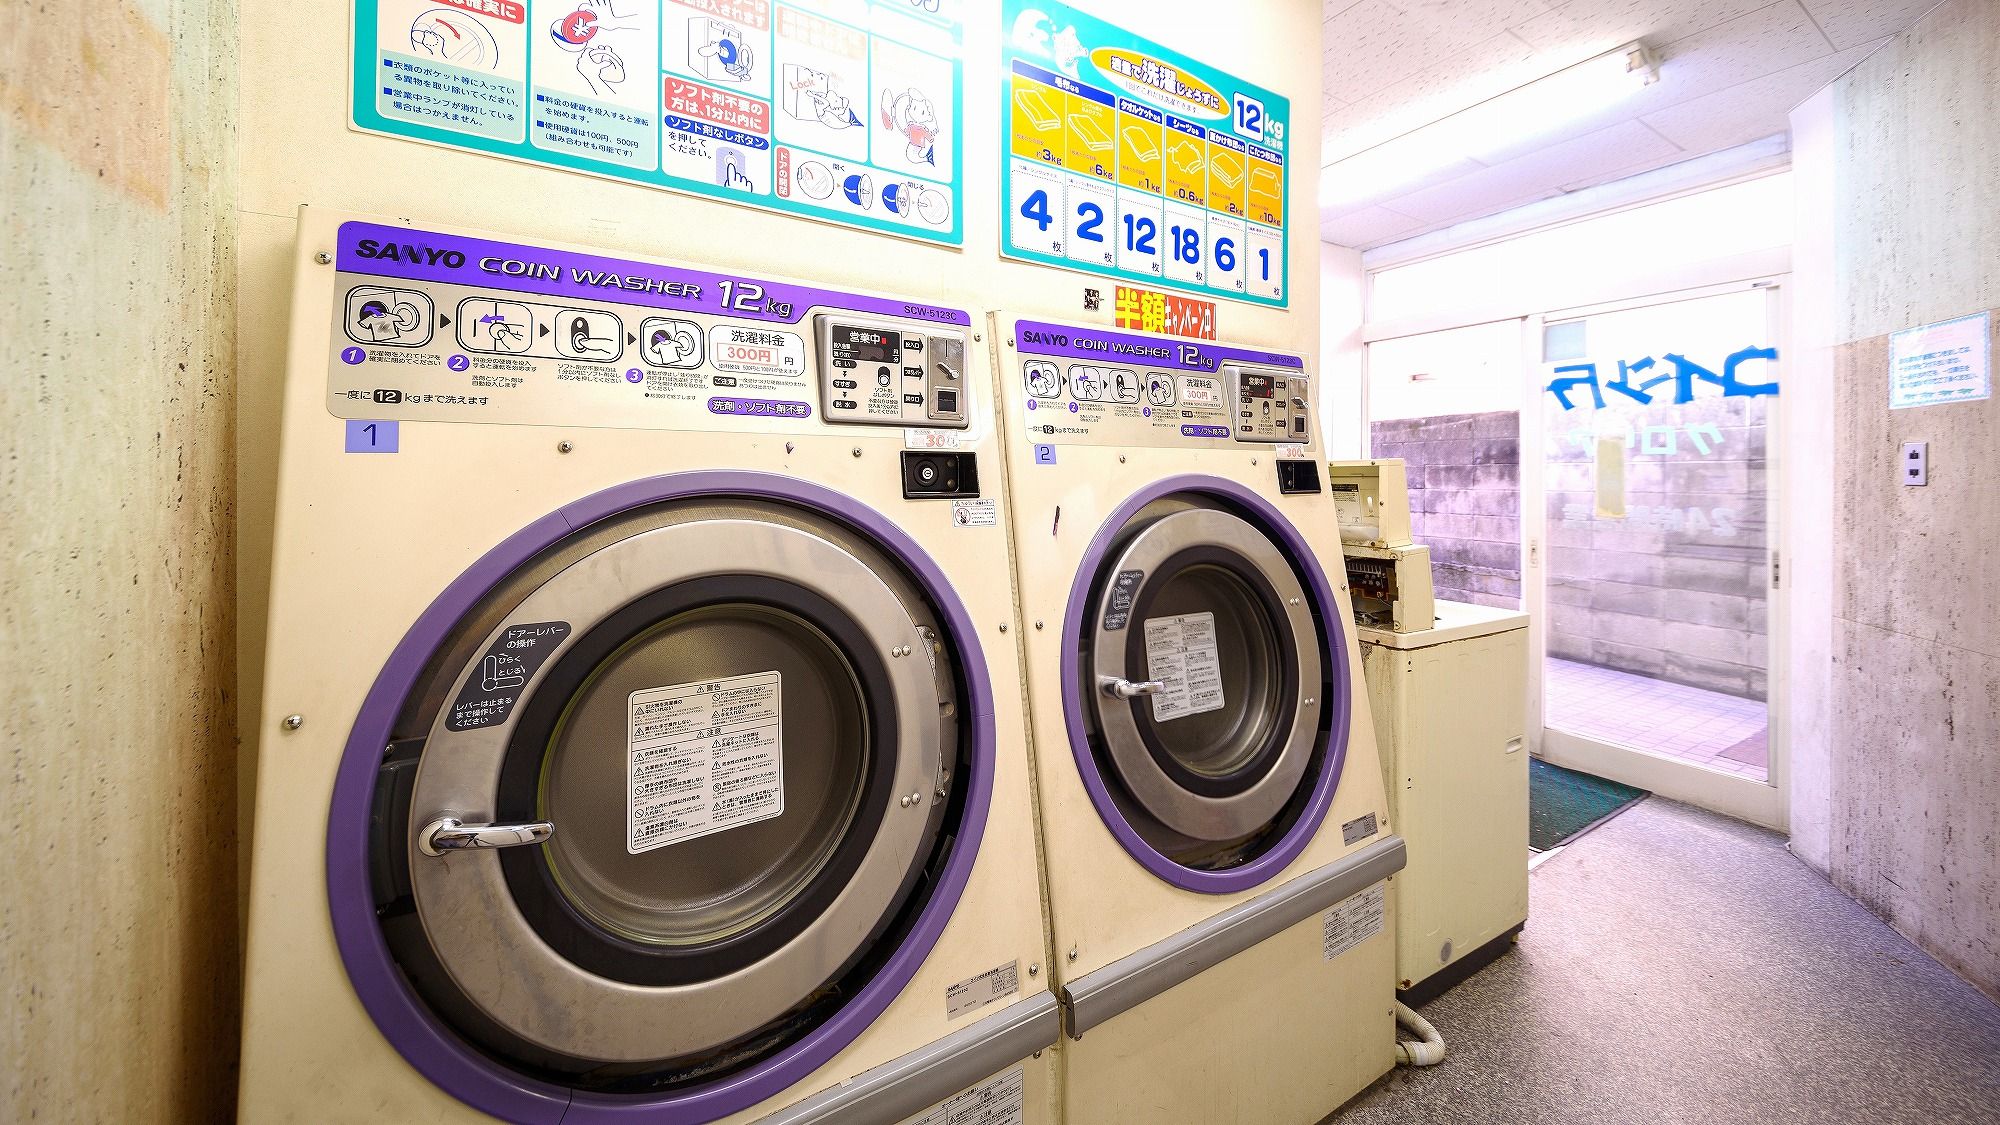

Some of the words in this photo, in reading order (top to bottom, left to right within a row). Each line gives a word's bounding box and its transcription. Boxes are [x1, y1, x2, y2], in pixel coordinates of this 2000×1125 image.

[671, 81, 763, 116] ソフト剤不要の
[393, 101, 483, 127] 場合はつかえません。
[1236, 100, 1261, 134] 12
[1264, 112, 1284, 140] kg
[668, 131, 707, 148] を押して
[670, 116, 765, 148] ソフト剤なしボタン
[668, 142, 712, 160] ください。
[1020, 189, 1053, 232] 4
[1076, 201, 1104, 243] 2
[1123, 213, 1156, 255] 12
[1170, 225, 1200, 265] 18
[1214, 236, 1236, 272] 6
[355, 239, 466, 269] SANYO
[478, 256, 561, 282] COIN
[569, 267, 703, 300] WASHER
[1258, 248, 1269, 281] 1
[904, 305, 957, 321] SCW-5123C
[731, 329, 785, 347] 洗濯料金
[849, 330, 881, 345] 営業中
[1023, 330, 1069, 347] SANYO
[1073, 337, 1109, 351] COIN
[1112, 341, 1172, 359] WASHER
[348, 349, 358, 362] 1
[452, 356, 464, 369] 2
[727, 346, 771, 363] 300円
[784, 356, 794, 366] 円
[629, 367, 639, 380] 3
[1186, 378, 1212, 389] 洗濯料金
[712, 399, 807, 416] 洗剤・ソフト剤不要
[363, 424, 376, 446] 1
[1040, 446, 1051, 461] 2
[508, 626, 564, 640] ドアーレバー
[506, 638, 537, 649] の操作
[498, 655, 521, 664] ひらく
[498, 667, 521, 676] とじる
[456, 697, 513, 711] レバーは止まる
[456, 706, 505, 720] まで操作して
[455, 717, 489, 727] ください
